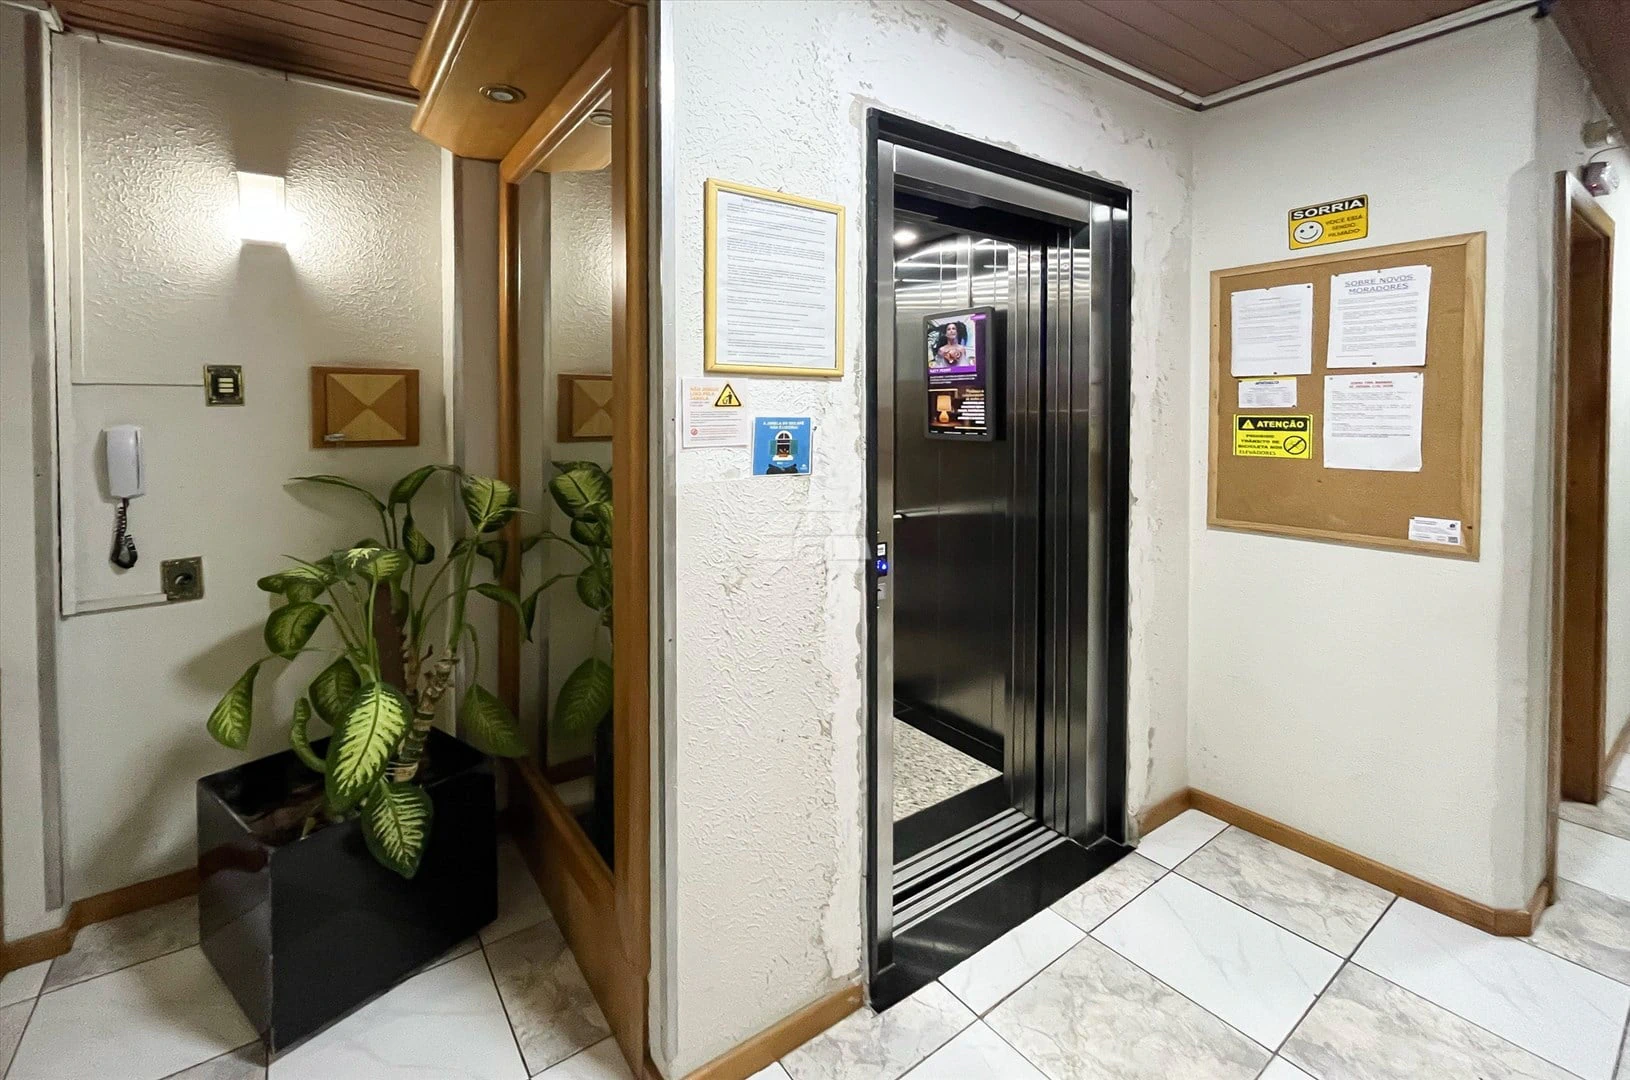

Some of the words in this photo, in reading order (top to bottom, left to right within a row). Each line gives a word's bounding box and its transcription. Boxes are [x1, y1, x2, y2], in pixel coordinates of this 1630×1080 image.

[1293, 199, 1364, 220] SORRIA
[1344, 278, 1376, 288] SOBRE
[1380, 273, 1414, 283] NOVOS
[1348, 282, 1409, 294] MORADORES
[1256, 419, 1305, 429] ATENÇÃO
